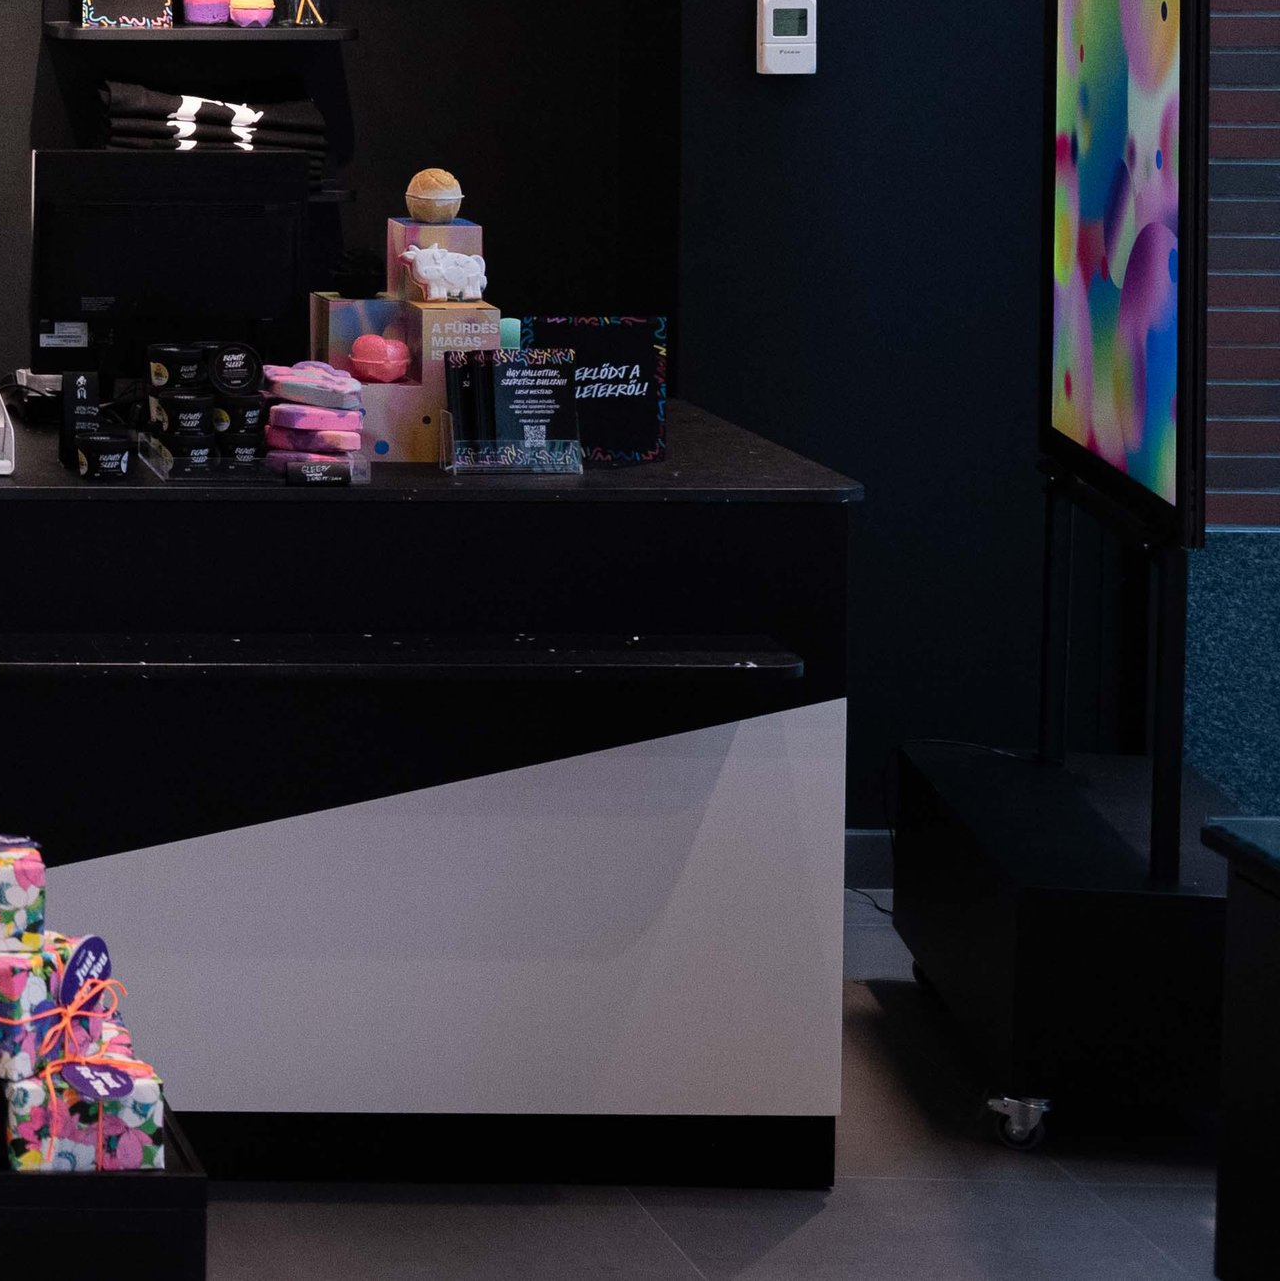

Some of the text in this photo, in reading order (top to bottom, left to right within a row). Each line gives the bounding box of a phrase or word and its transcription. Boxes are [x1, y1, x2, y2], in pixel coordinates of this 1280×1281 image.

[431, 320, 500, 335] A FÜRDÉS
[431, 335, 487, 348] MAGAS-
[574, 365, 641, 382] EKLŐDJ A
[575, 380, 649, 400] LETEKRŐL!
[75, 950, 96, 984] Just
[88, 953, 108, 981] You
